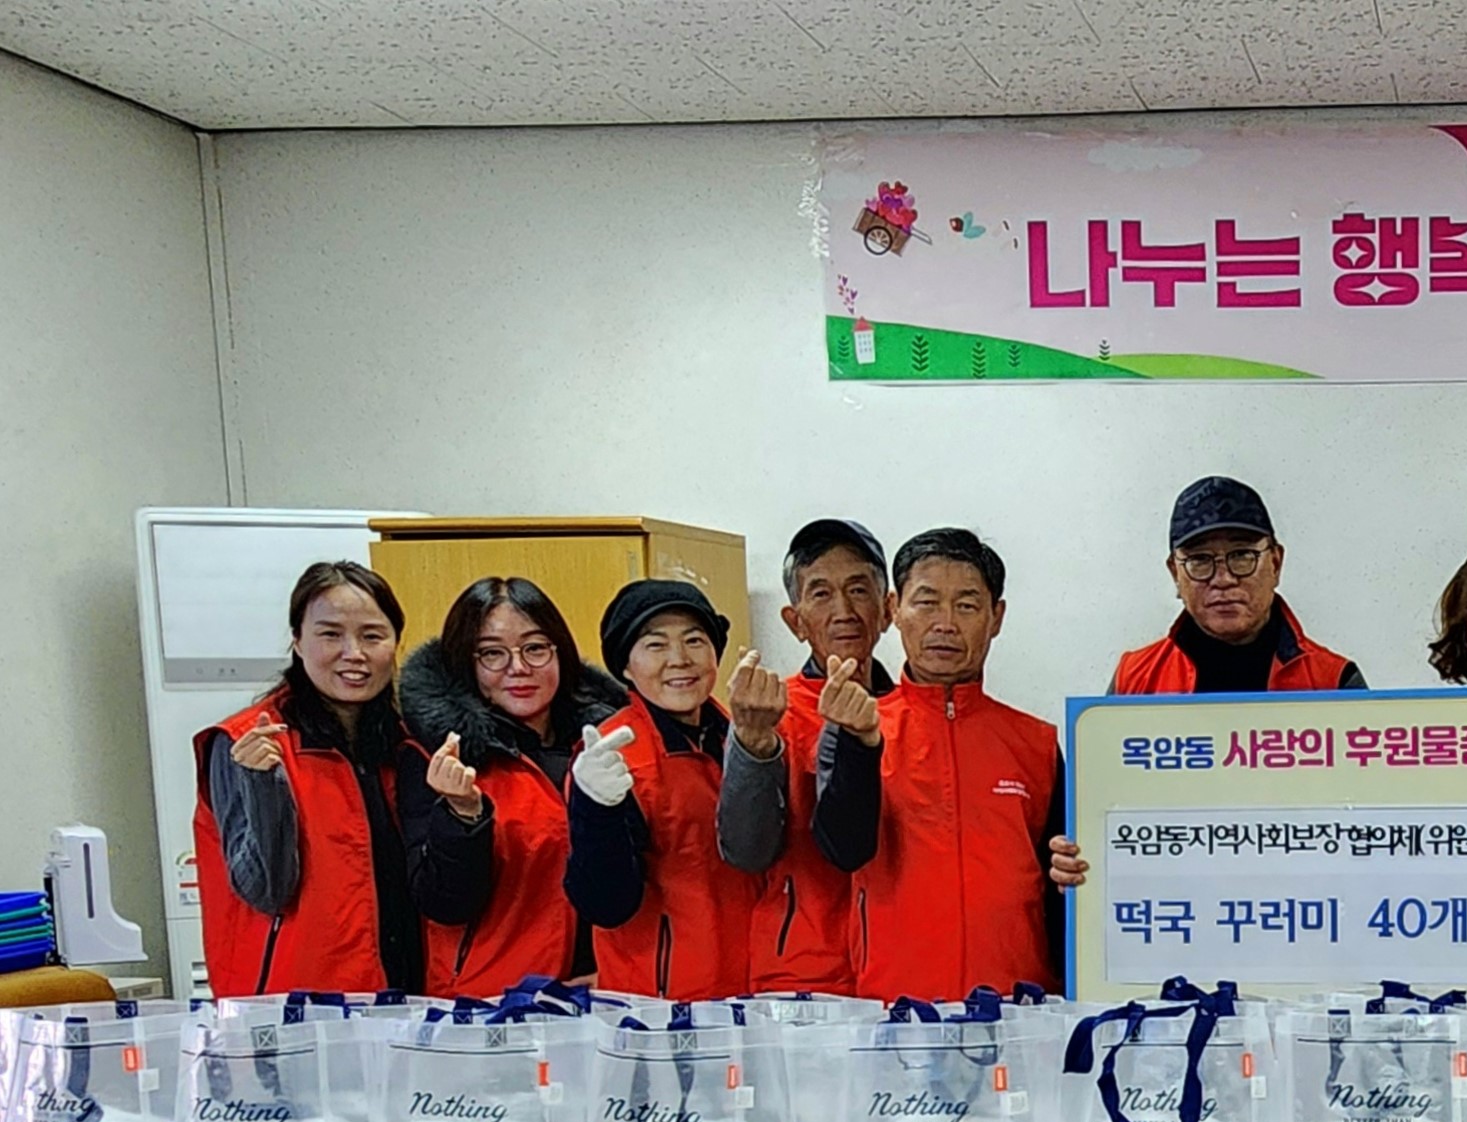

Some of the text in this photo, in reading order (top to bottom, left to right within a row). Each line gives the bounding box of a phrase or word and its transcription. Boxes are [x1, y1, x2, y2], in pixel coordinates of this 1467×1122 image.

[1027, 219, 1301, 308] 나누는
[1122, 736, 1215, 770] 옥암동
[1222, 728, 1335, 769] 사랑의
[1113, 900, 1196, 944] 떡국
[1216, 898, 1338, 943] 꾸러미
[1368, 898, 1467, 943] 40개
[1120, 1087, 1218, 1121] Nothg
[1329, 1083, 1433, 1118] Nothing
